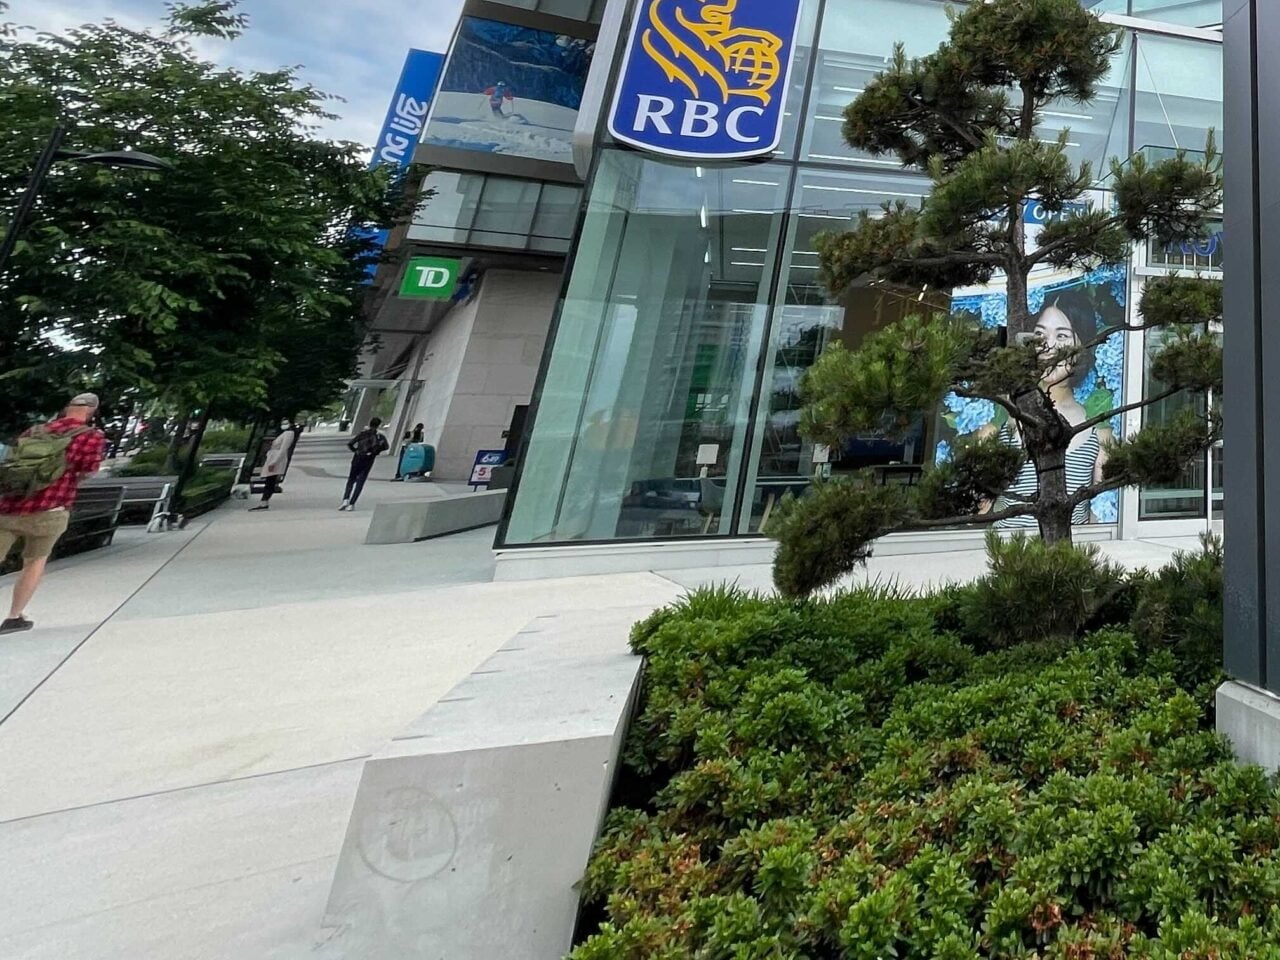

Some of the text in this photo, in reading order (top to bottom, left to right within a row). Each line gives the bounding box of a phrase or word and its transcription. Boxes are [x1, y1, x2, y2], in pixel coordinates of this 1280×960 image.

[390, 92, 428, 137] life
[633, 94, 764, 142] RBC
[415, 266, 450, 288] TD
